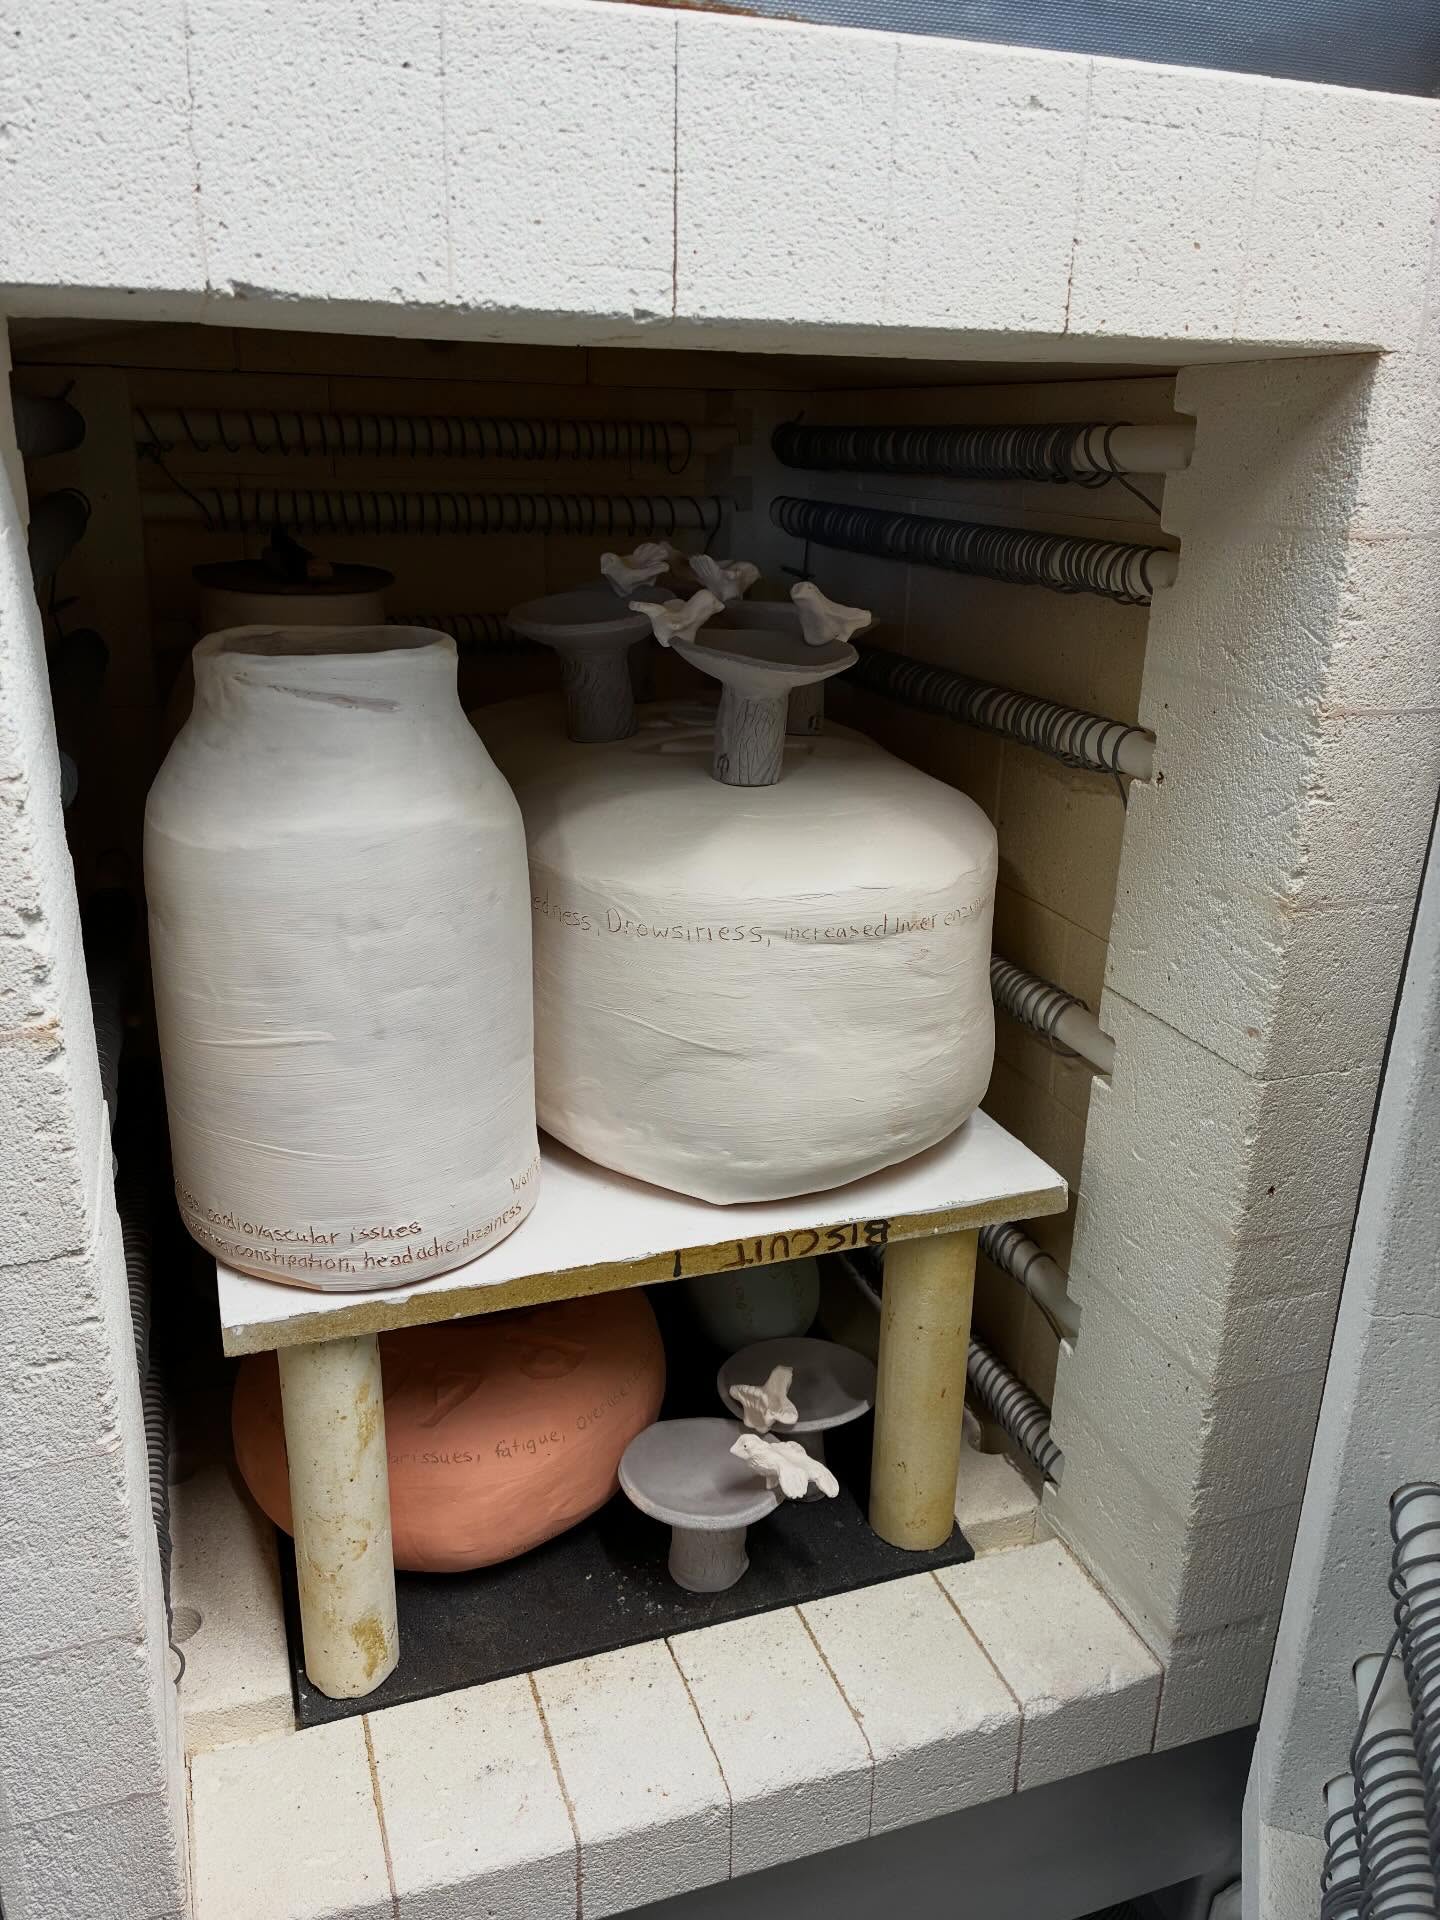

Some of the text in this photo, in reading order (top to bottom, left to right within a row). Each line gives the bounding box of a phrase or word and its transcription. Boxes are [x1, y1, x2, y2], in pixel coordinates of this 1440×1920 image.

[783, 914, 888, 942] increased
[895, 913, 938, 934] liver
[208, 1207, 341, 1245] cardiovascular
[350, 1220, 423, 1244] issues
[721, 1218, 892, 1268] BISCUIT
[495, 1431, 567, 1459] fatigue,
